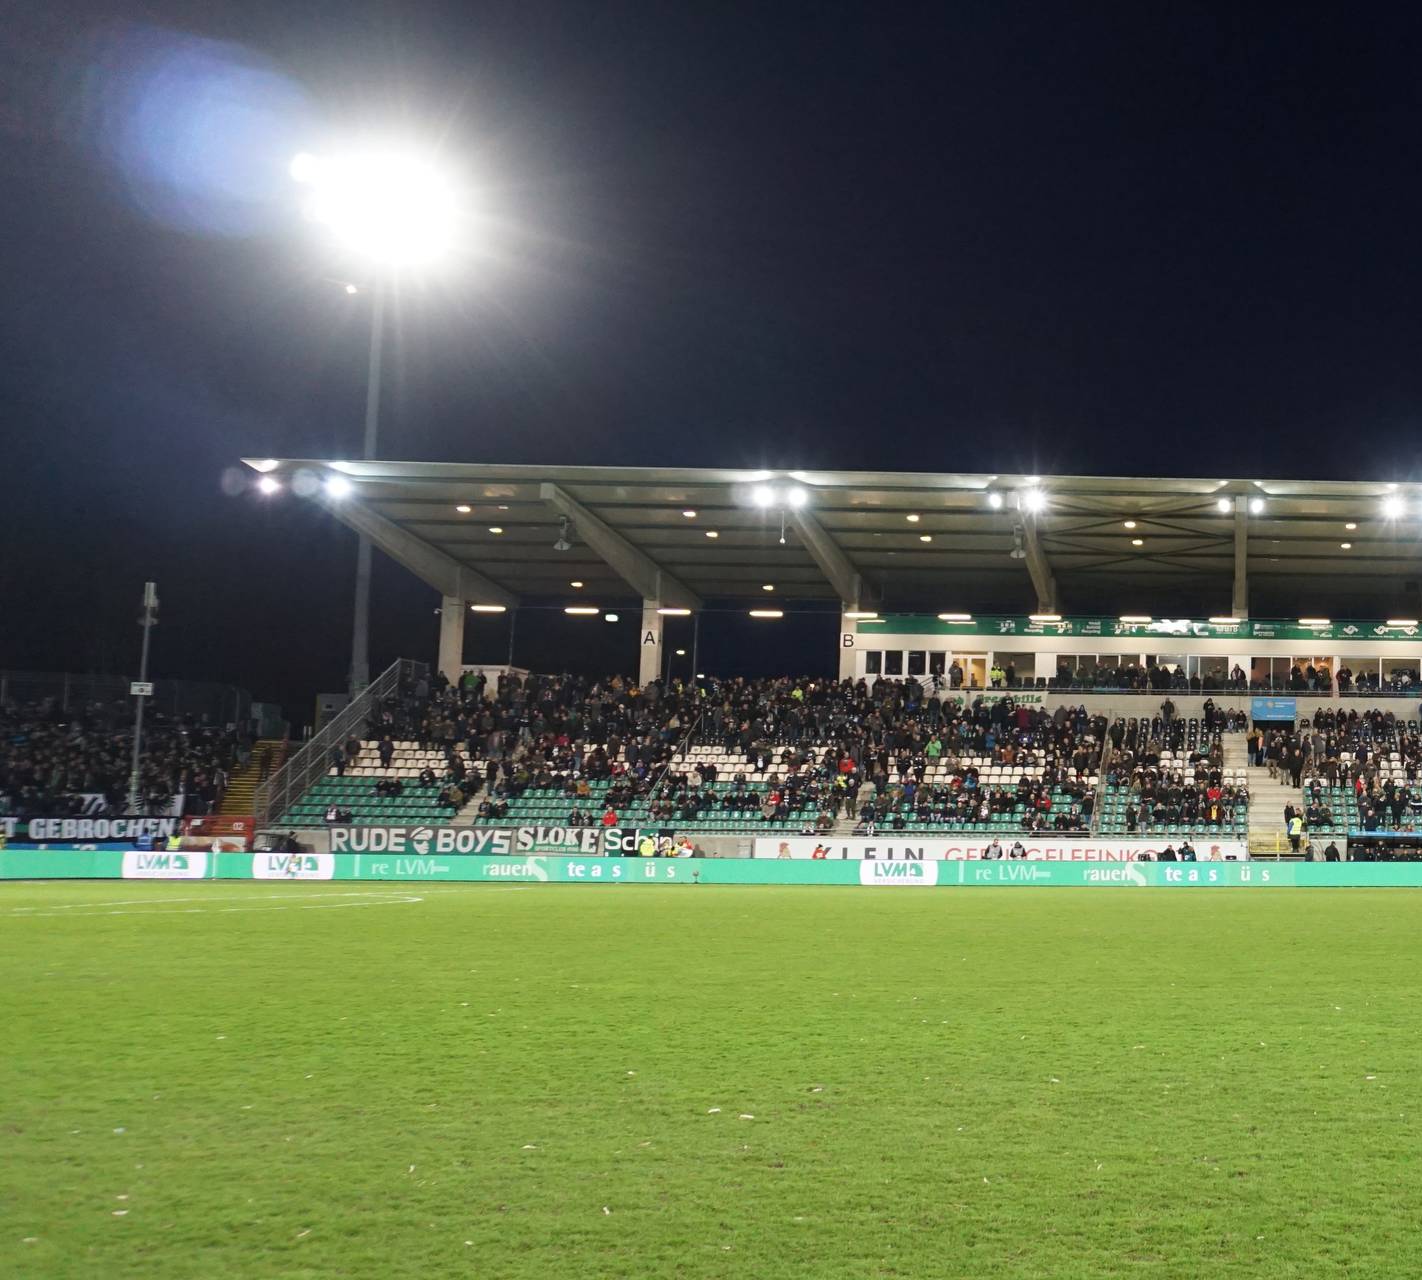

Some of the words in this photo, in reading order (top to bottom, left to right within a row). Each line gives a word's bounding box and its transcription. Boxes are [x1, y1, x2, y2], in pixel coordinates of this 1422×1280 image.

[643, 630, 656, 645] A
[843, 633, 855, 648] B
[28, 817, 176, 840] GEBROCHEN
[233, 822, 244, 831] 02
[331, 827, 406, 852] RUDE
[437, 828, 512, 854] BOYS
[517, 826, 600, 853] SLOKE
[137, 855, 170, 869] LVM
[874, 862, 908, 877] LVM
